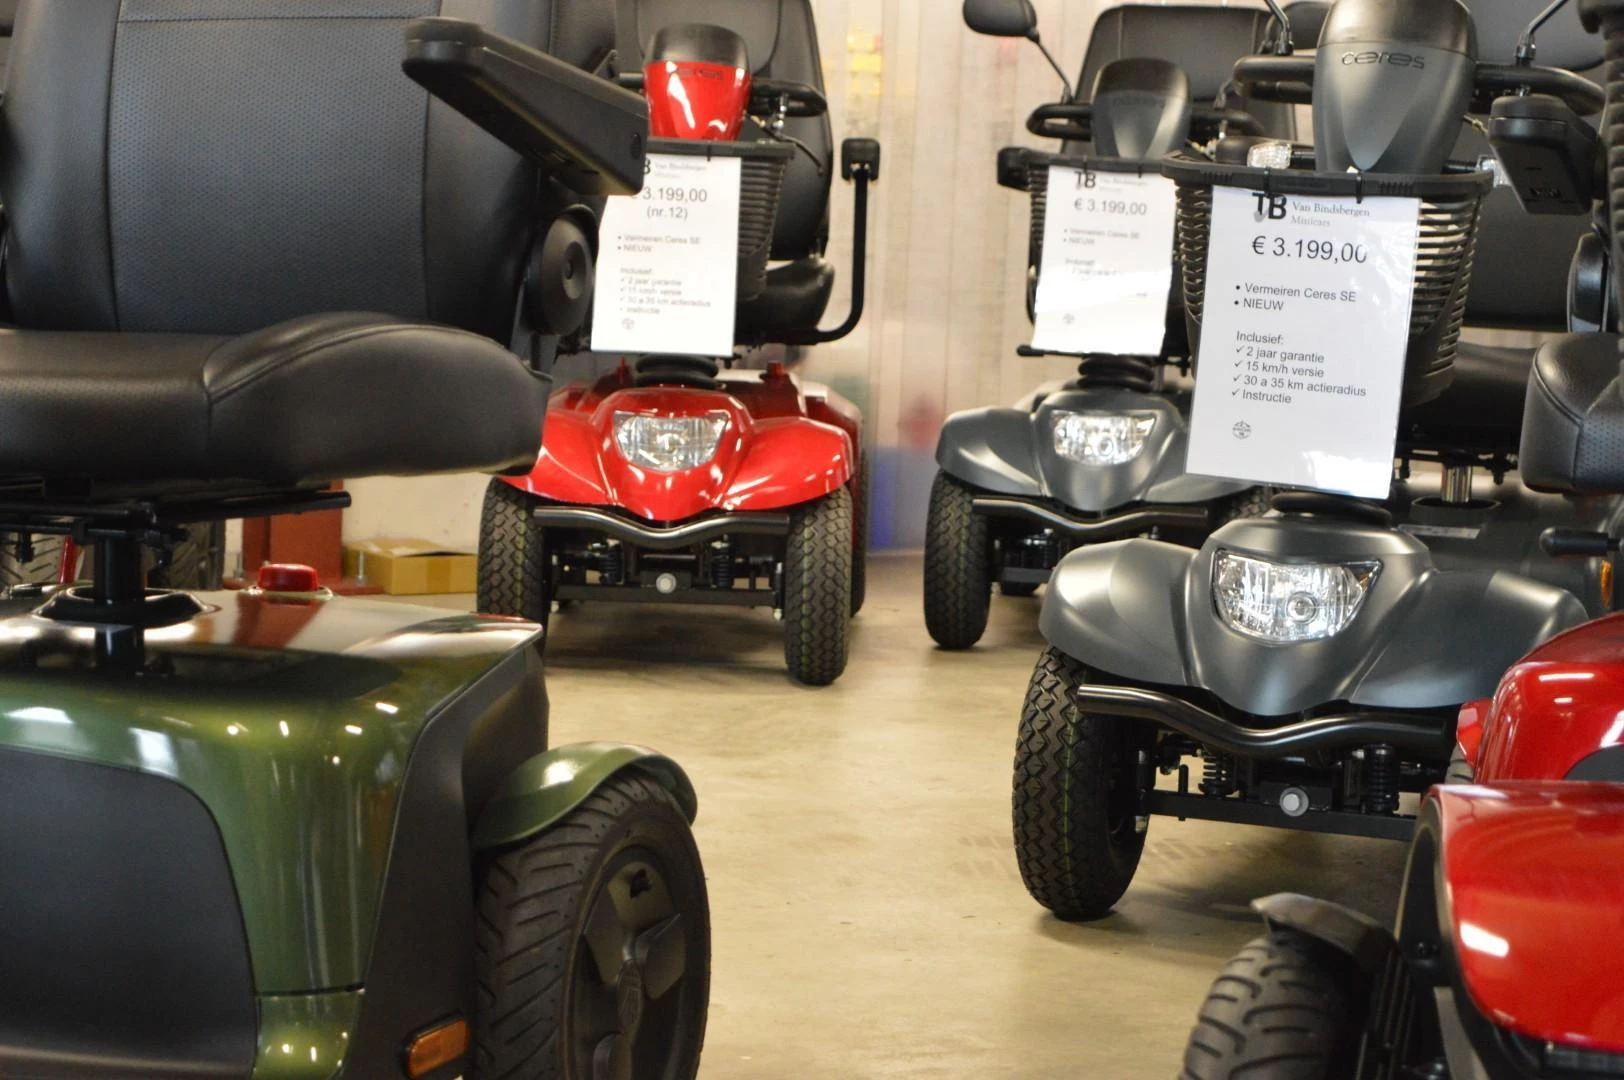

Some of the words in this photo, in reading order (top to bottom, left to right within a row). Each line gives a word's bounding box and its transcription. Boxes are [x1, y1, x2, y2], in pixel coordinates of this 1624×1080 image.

[1342, 51, 1425, 69] ceres
[642, 186, 708, 203] 3.199,00
[646, 206, 689, 221] (nr.12)
[1074, 198, 1083, 211] €
[1087, 198, 1147, 216] 3.199,00
[1252, 192, 1287, 220] TB
[1292, 201, 1311, 212] Van
[1314, 203, 1370, 217] Bindsbergen
[1290, 215, 1331, 227] Minicars
[1252, 235, 1266, 255] €
[1272, 237, 1367, 264] 3.199,00
[1245, 282, 1300, 297] Vermeiren
[1304, 287, 1336, 300] Ceres
[1340, 290, 1356, 302] SE
[1243, 298, 1284, 311] NIEUW
[1236, 330, 1284, 345] Inclusief:
[1246, 346, 1254, 357] 2
[1255, 347, 1277, 360] jaar
[1280, 351, 1325, 364] garantie
[1247, 360, 1259, 372] 15
[1262, 362, 1288, 375] km/h
[1292, 366, 1325, 378] versie
[1243, 375, 1258, 386] 30
[1260, 378, 1267, 387] a
[1270, 377, 1284, 388] 35
[1287, 379, 1304, 391] km
[1306, 381, 1367, 397] actieradius
[1242, 389, 1292, 404] Instructie
